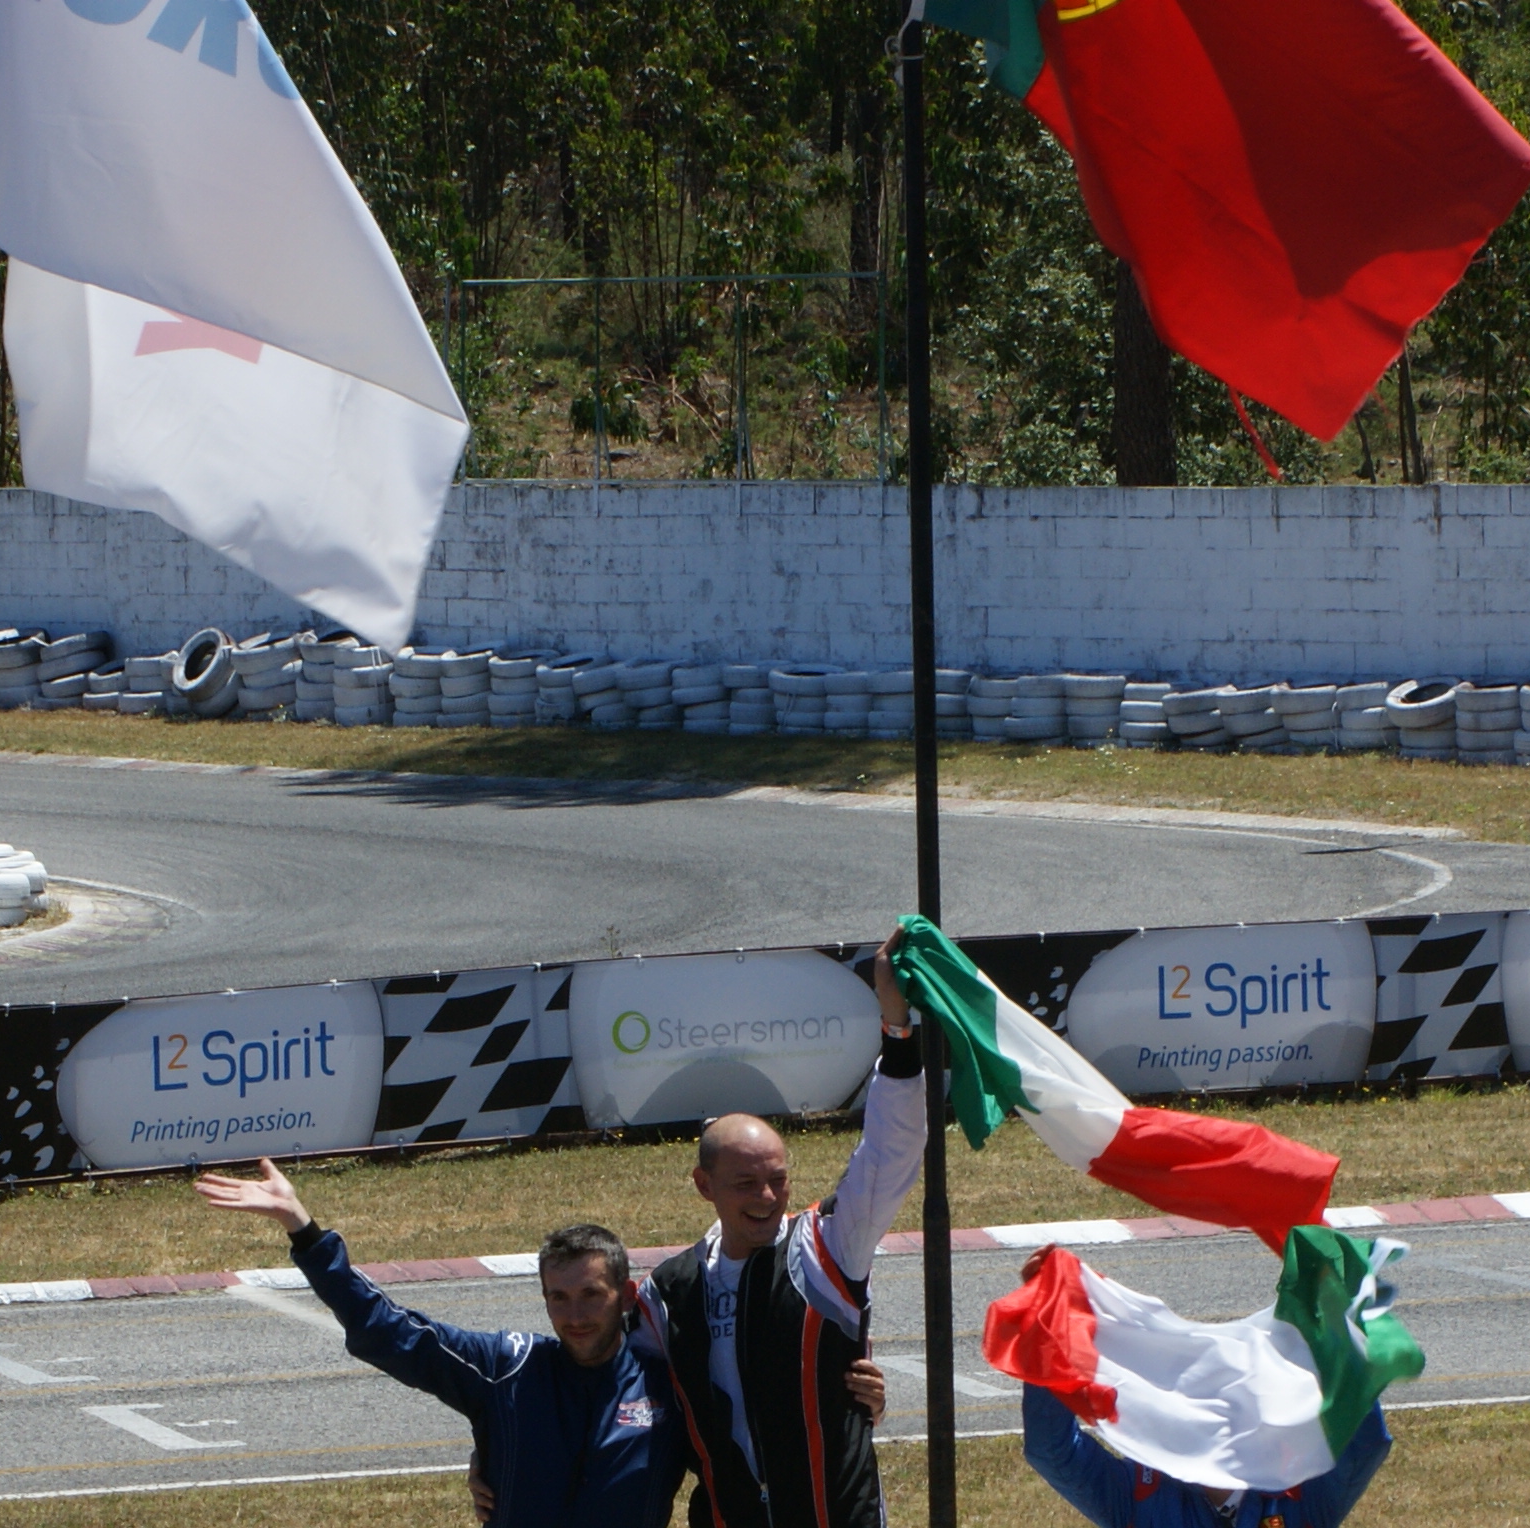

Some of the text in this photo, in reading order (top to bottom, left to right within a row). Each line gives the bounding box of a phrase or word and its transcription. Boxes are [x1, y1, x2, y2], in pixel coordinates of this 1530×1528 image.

[1204, 957, 1331, 1029] Spirit
[657, 1004, 845, 1049] Steersman
[202, 1021, 335, 1098] Spirit
[1137, 1039, 1313, 1072] Printing passion.
[131, 1107, 316, 1144] Printing passion.
